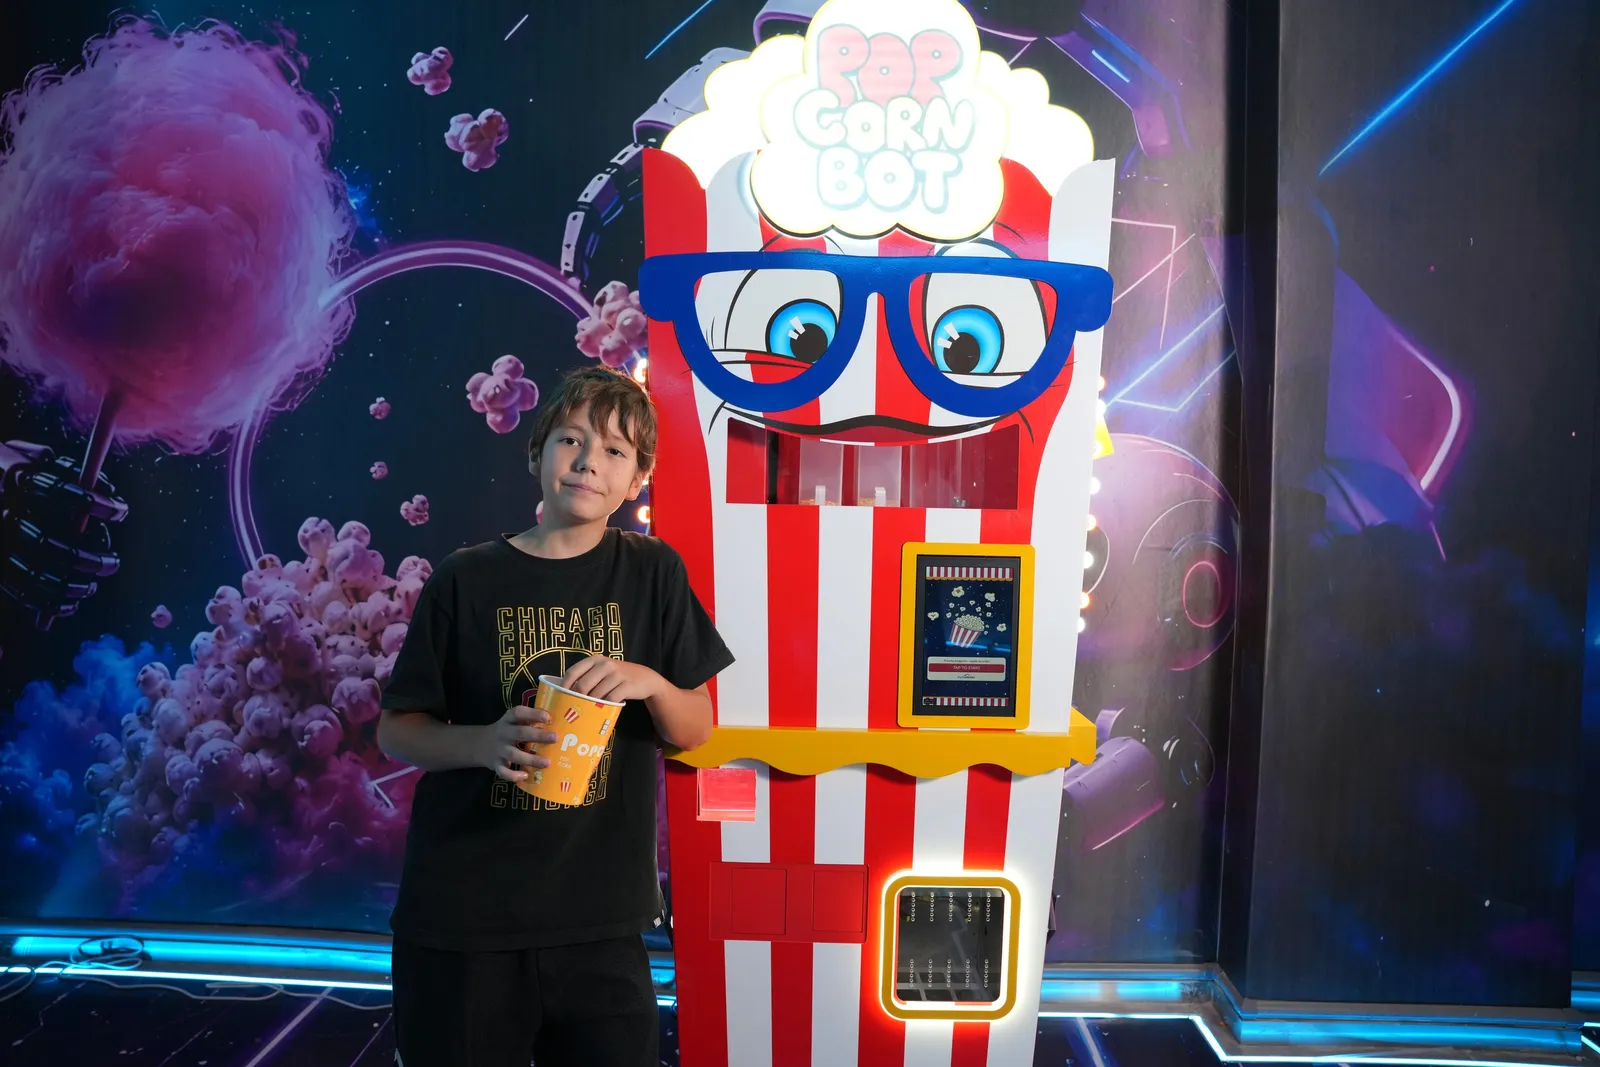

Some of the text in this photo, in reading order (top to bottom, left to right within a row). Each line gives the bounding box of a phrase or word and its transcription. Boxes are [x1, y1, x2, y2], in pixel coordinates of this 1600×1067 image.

[817, 23, 963, 107] POP
[793, 88, 975, 156] CORN
[816, 147, 963, 214] BOT
[497, 602, 621, 632] CHICAGO
